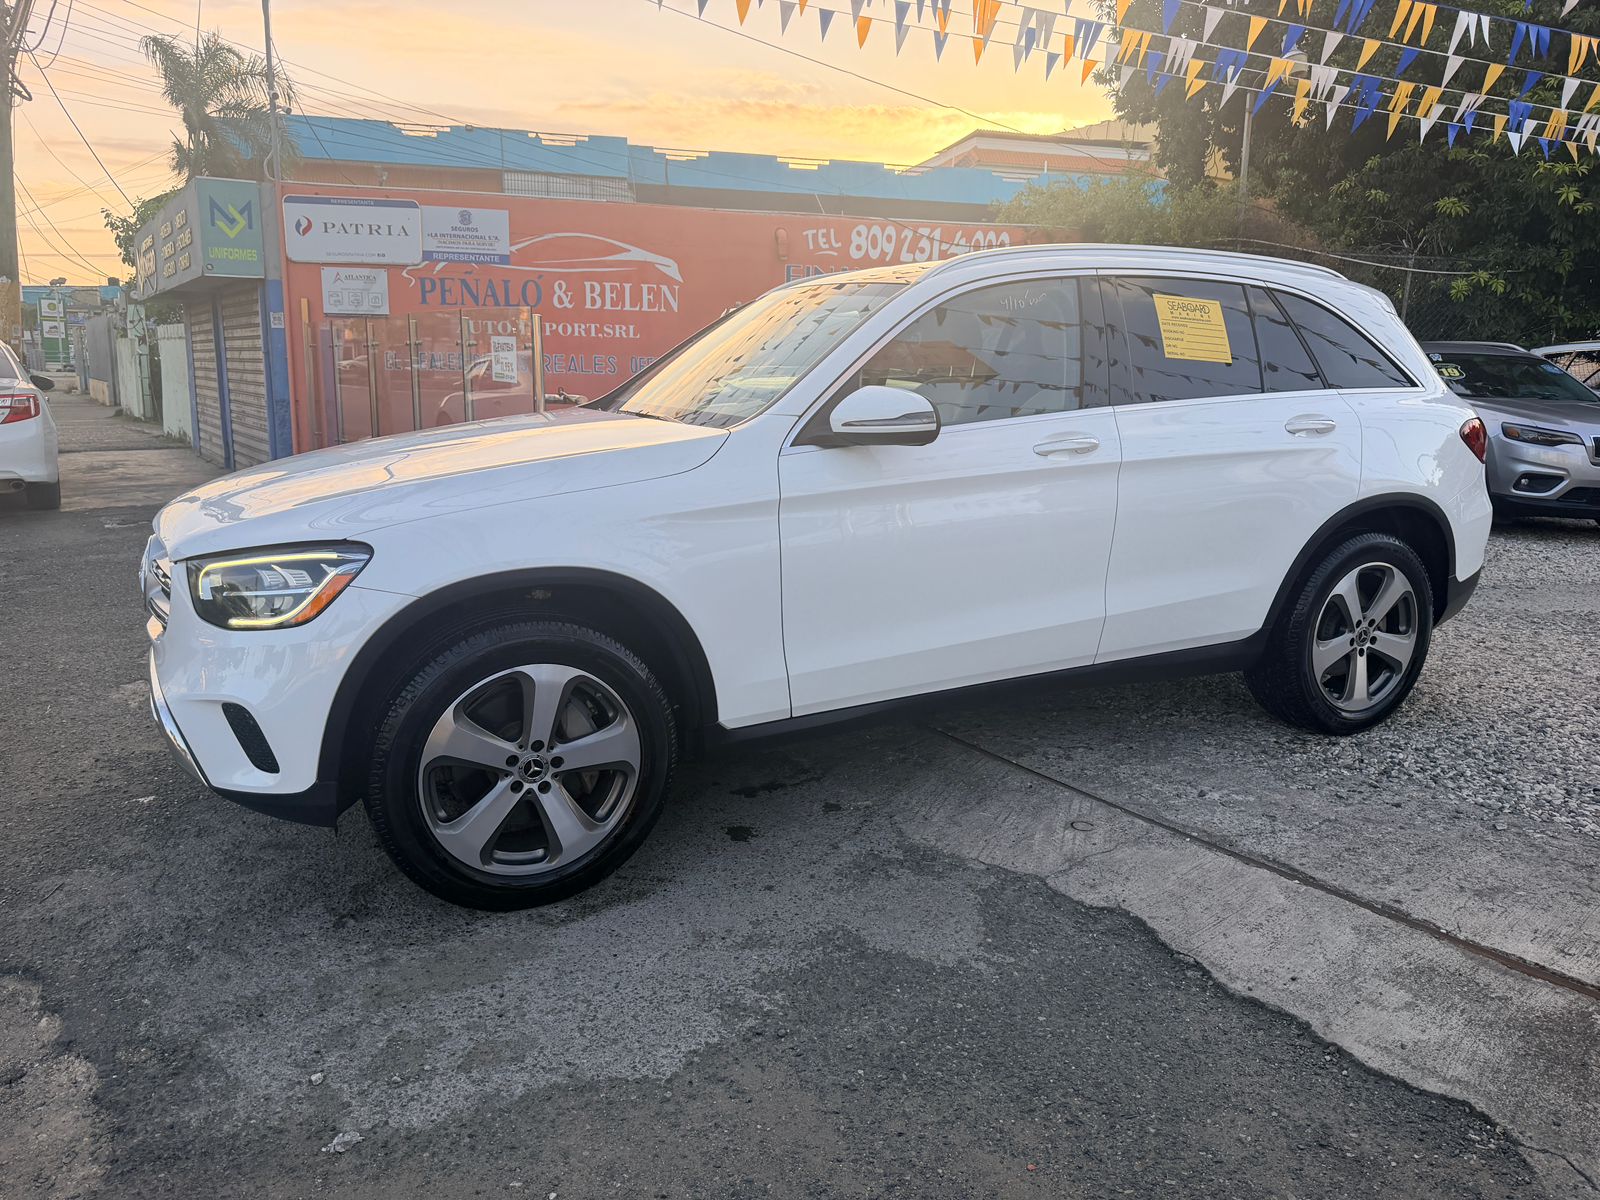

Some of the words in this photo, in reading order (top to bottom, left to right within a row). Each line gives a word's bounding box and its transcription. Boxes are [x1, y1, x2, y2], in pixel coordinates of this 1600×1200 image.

[322, 222, 410, 237] PATRIA
[803, 228, 842, 250] TEL
[849, 224, 897, 261] 809
[208, 247, 257, 261] UNIFORMES
[433, 252, 500, 262] REPRESENTANTE
[418, 271, 544, 308] PEÑALÓ
[552, 280, 575, 309] &
[584, 281, 680, 312] BELEN
[1167, 301, 1211, 315] SEABOARD
[543, 353, 617, 375] REALES
